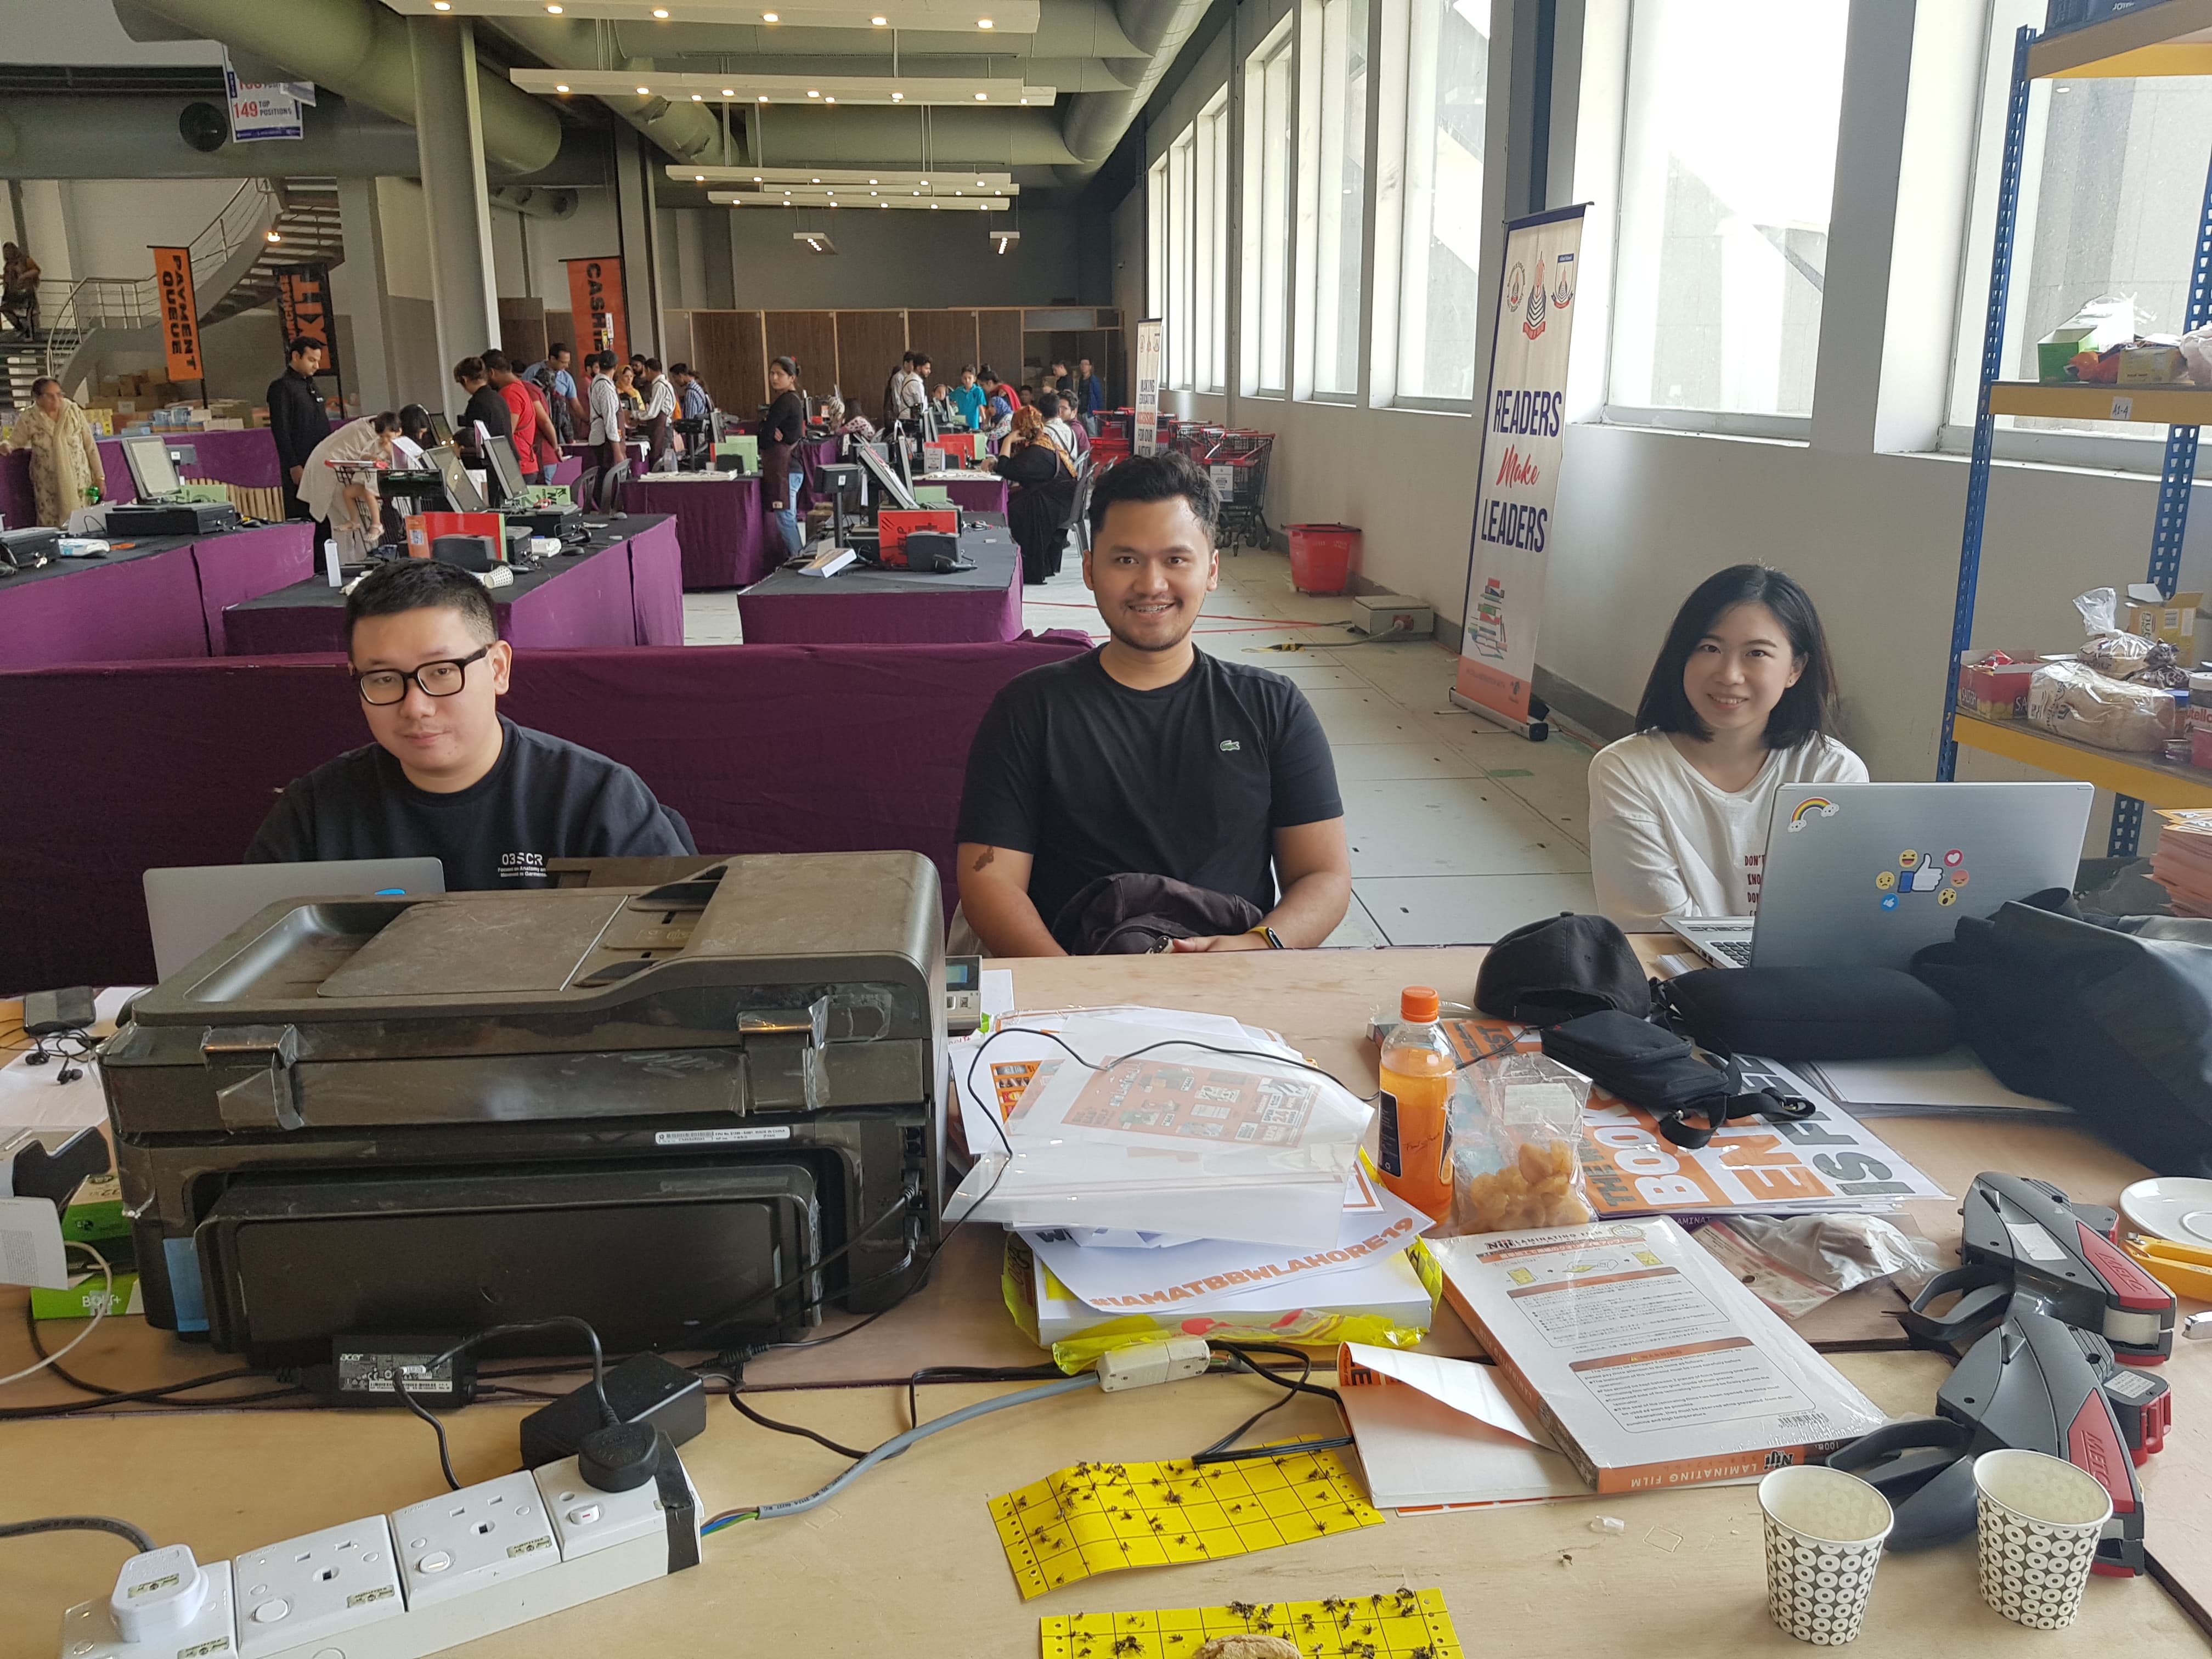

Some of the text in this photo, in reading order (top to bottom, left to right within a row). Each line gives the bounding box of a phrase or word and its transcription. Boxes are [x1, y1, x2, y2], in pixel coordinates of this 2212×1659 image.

[233, 101, 258, 119] 149
[260, 107, 292, 116] POSITIONS
[162, 271, 182, 354] QUEUE
[173, 255, 196, 370] PAYMENT
[1493, 390, 1562, 437] READERS
[1496, 443, 1540, 488] Make
[1481, 499, 1548, 552] LEADERS
[1586, 1164, 1636, 1207] THE
[1813, 1152, 1916, 1196] IS
[1089, 1217, 1414, 1307] #IAMATBBWLAHORE19
[1485, 1238, 1514, 1251] Niji
[1515, 1233, 1577, 1247] LAMINATING
[1630, 1450, 1795, 1488] Niji LAMINATING FILM
